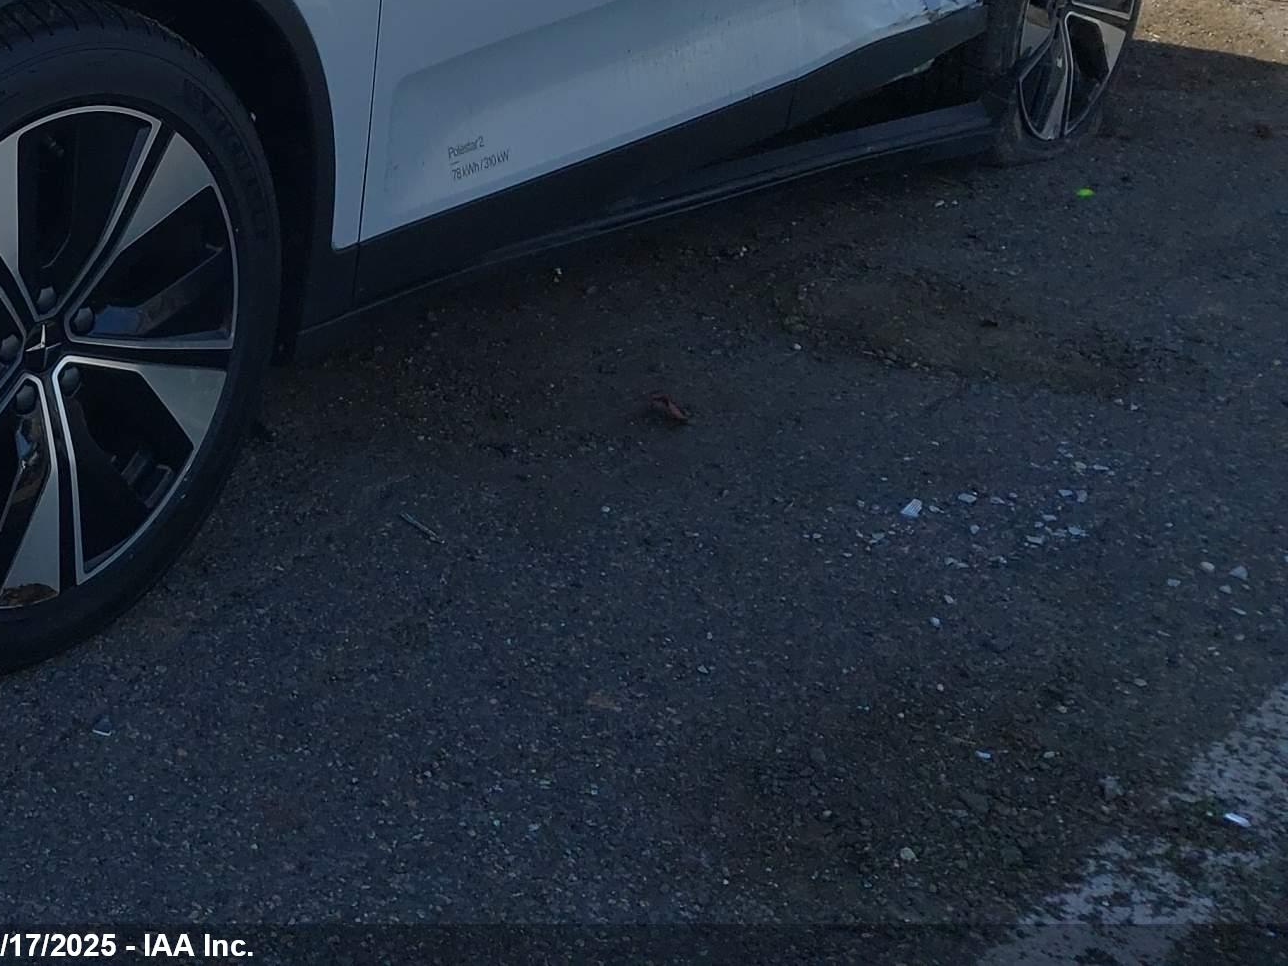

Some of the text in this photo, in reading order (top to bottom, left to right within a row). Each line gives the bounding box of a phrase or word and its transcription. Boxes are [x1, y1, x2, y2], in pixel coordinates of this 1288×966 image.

[448, 135, 485, 159] Polestar 2
[451, 167, 462, 180] 78
